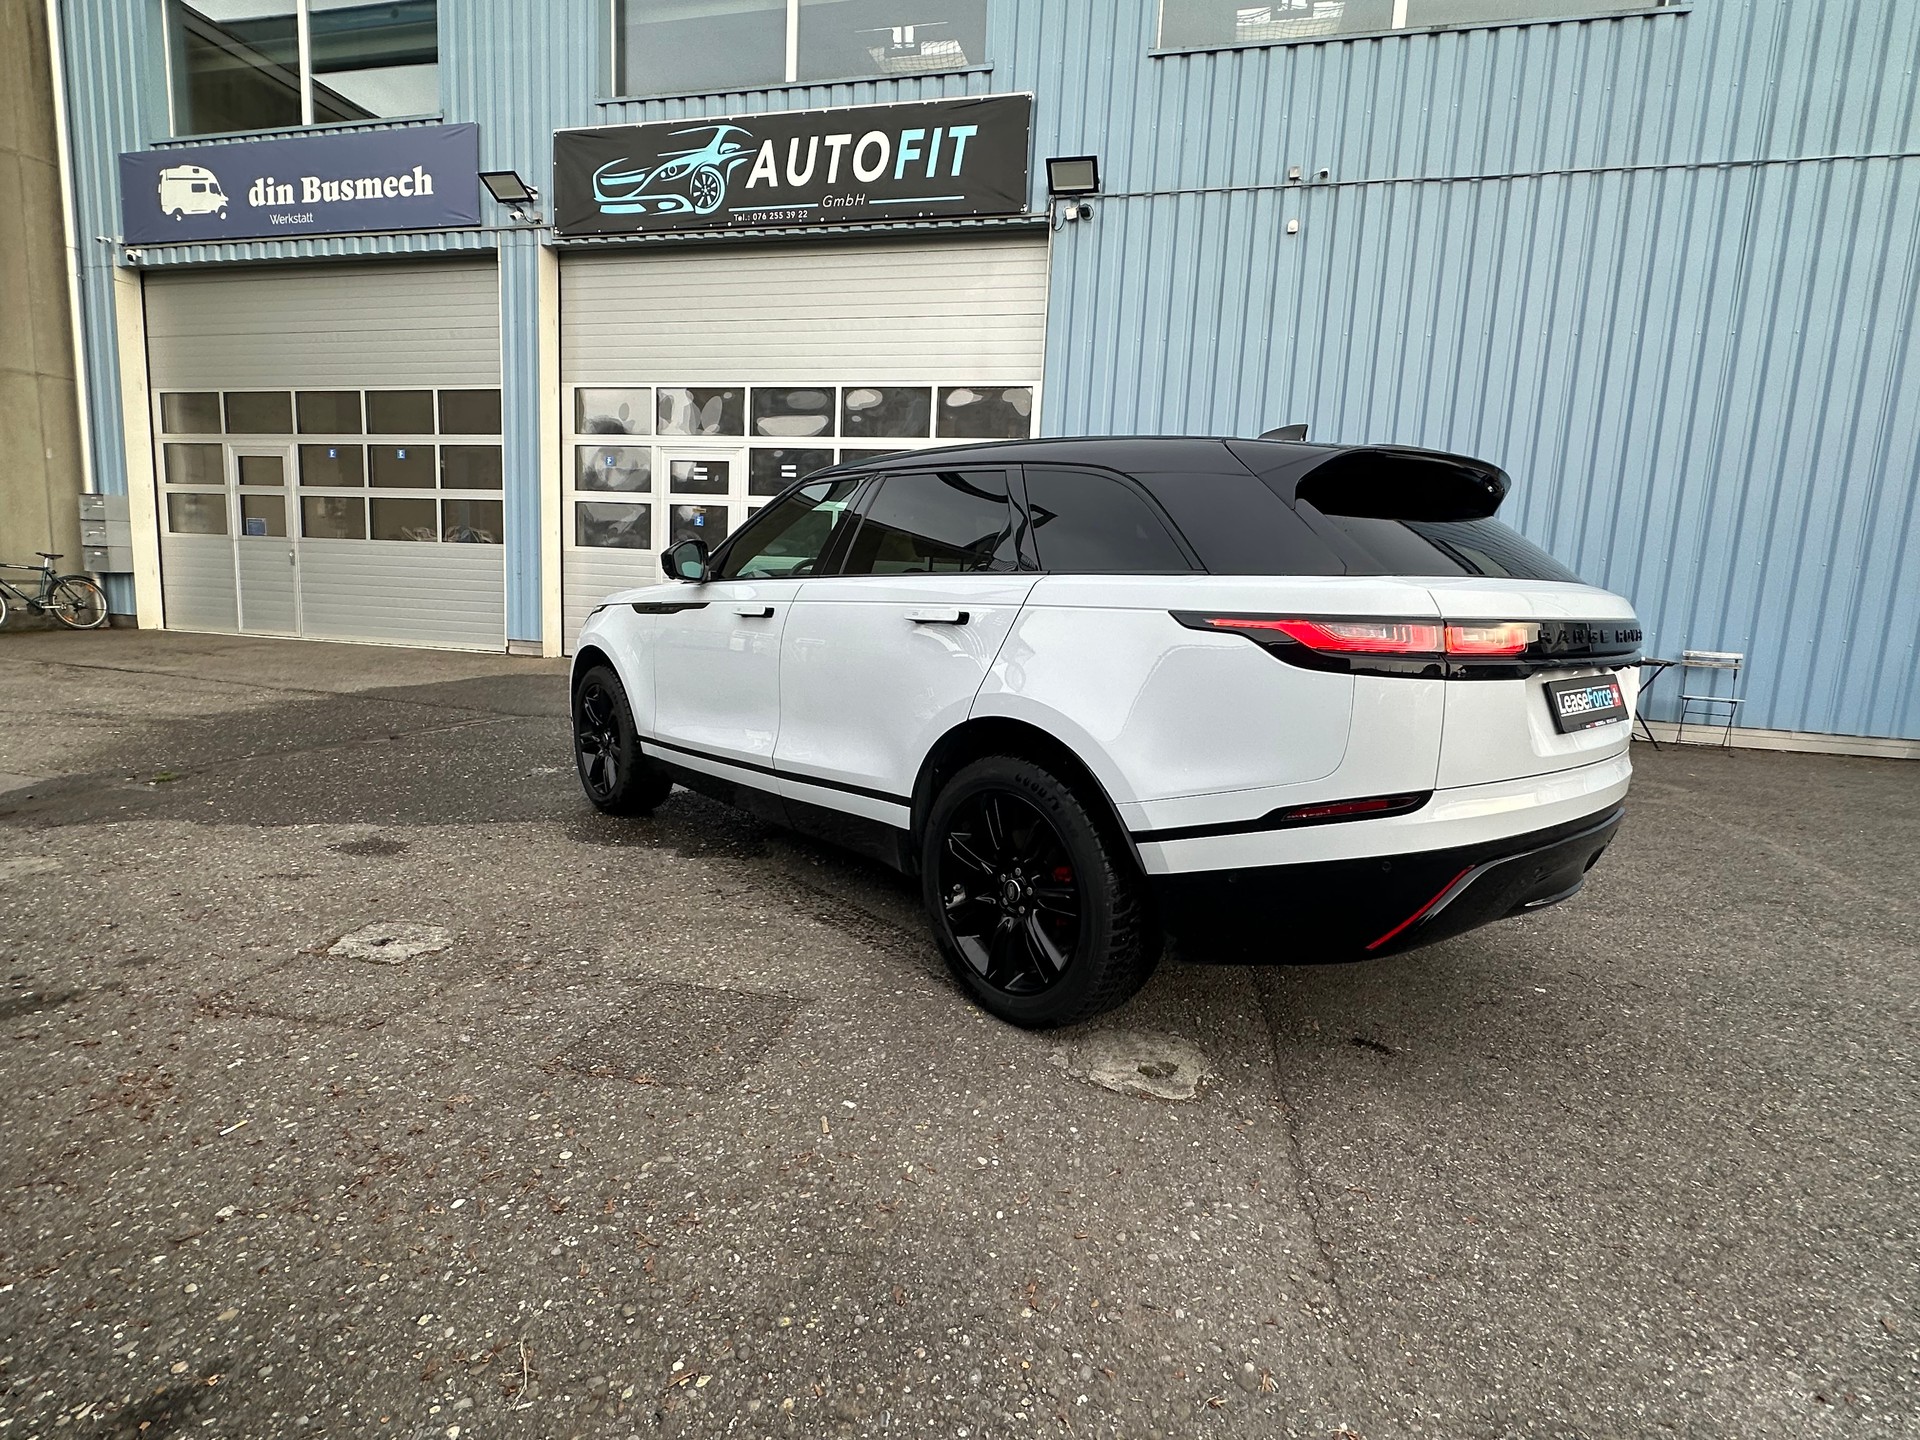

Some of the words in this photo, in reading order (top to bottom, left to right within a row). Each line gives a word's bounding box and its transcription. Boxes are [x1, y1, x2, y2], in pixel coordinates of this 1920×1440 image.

[745, 124, 977, 189] AUTOFIT
[248, 176, 295, 207] din
[300, 165, 434, 204] Busmech
[821, 193, 866, 209] GmbH
[269, 212, 314, 225] Werkstatt
[752, 212, 767, 221] 076
[769, 211, 784, 220] 255
[786, 210, 796, 219] 39
[798, 209, 808, 218] 22
[1556, 687, 1614, 714] LeaseForce
